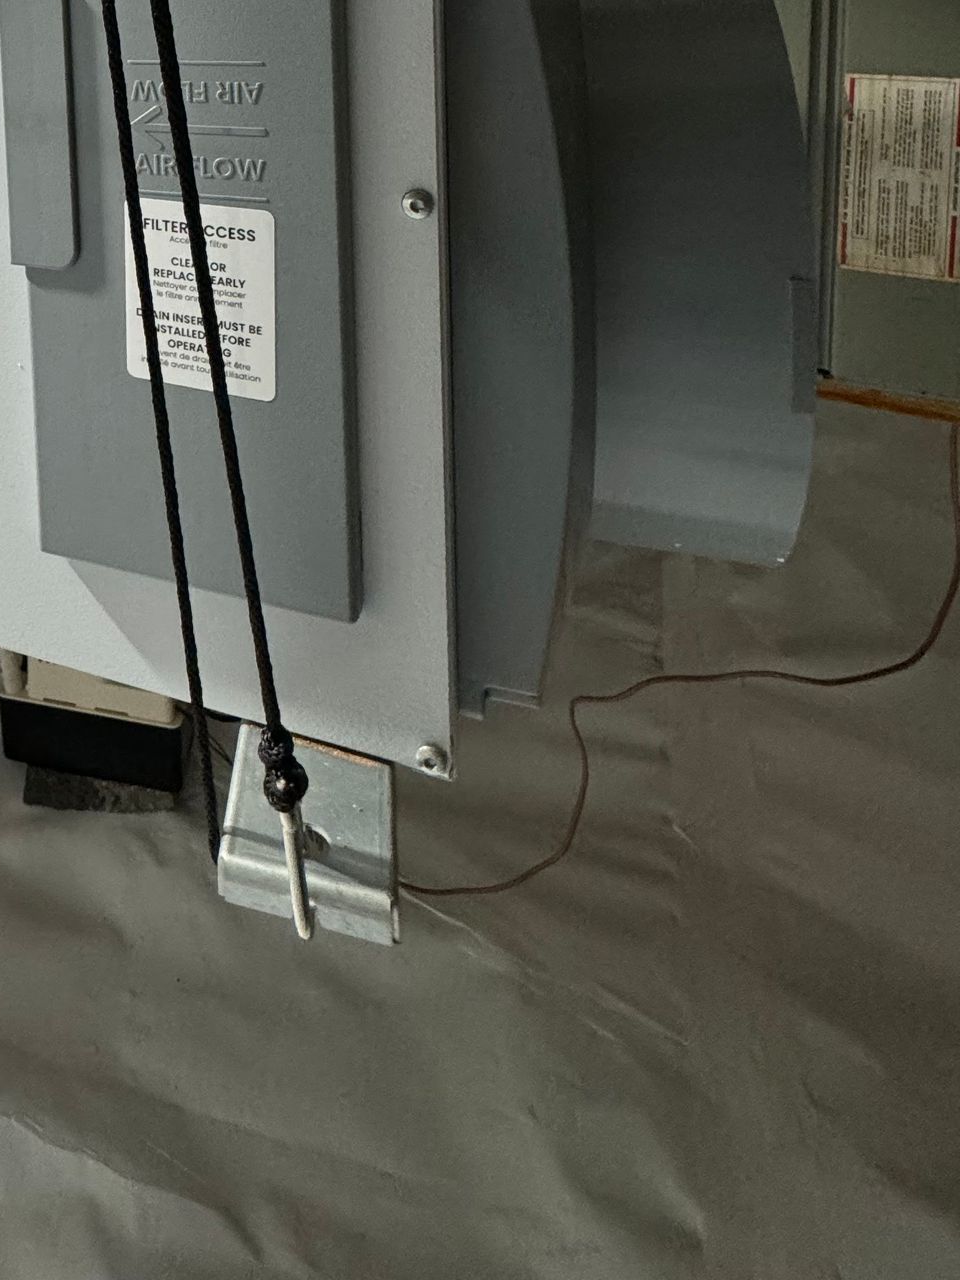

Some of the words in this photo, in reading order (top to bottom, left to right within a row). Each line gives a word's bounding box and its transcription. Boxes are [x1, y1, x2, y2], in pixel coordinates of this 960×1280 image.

[215, 78, 263, 105] AIR
[136, 153, 178, 177] AIR
[143, 217, 188, 234] FILTER
[203, 223, 255, 242] CCESS
[170, 256, 193, 268] CLE
[209, 261, 226, 272] OR
[153, 267, 194, 281] REPLAC
[211, 275, 246, 288] EARLY
[172, 312, 203, 326] INSER
[248, 324, 262, 335] BE
